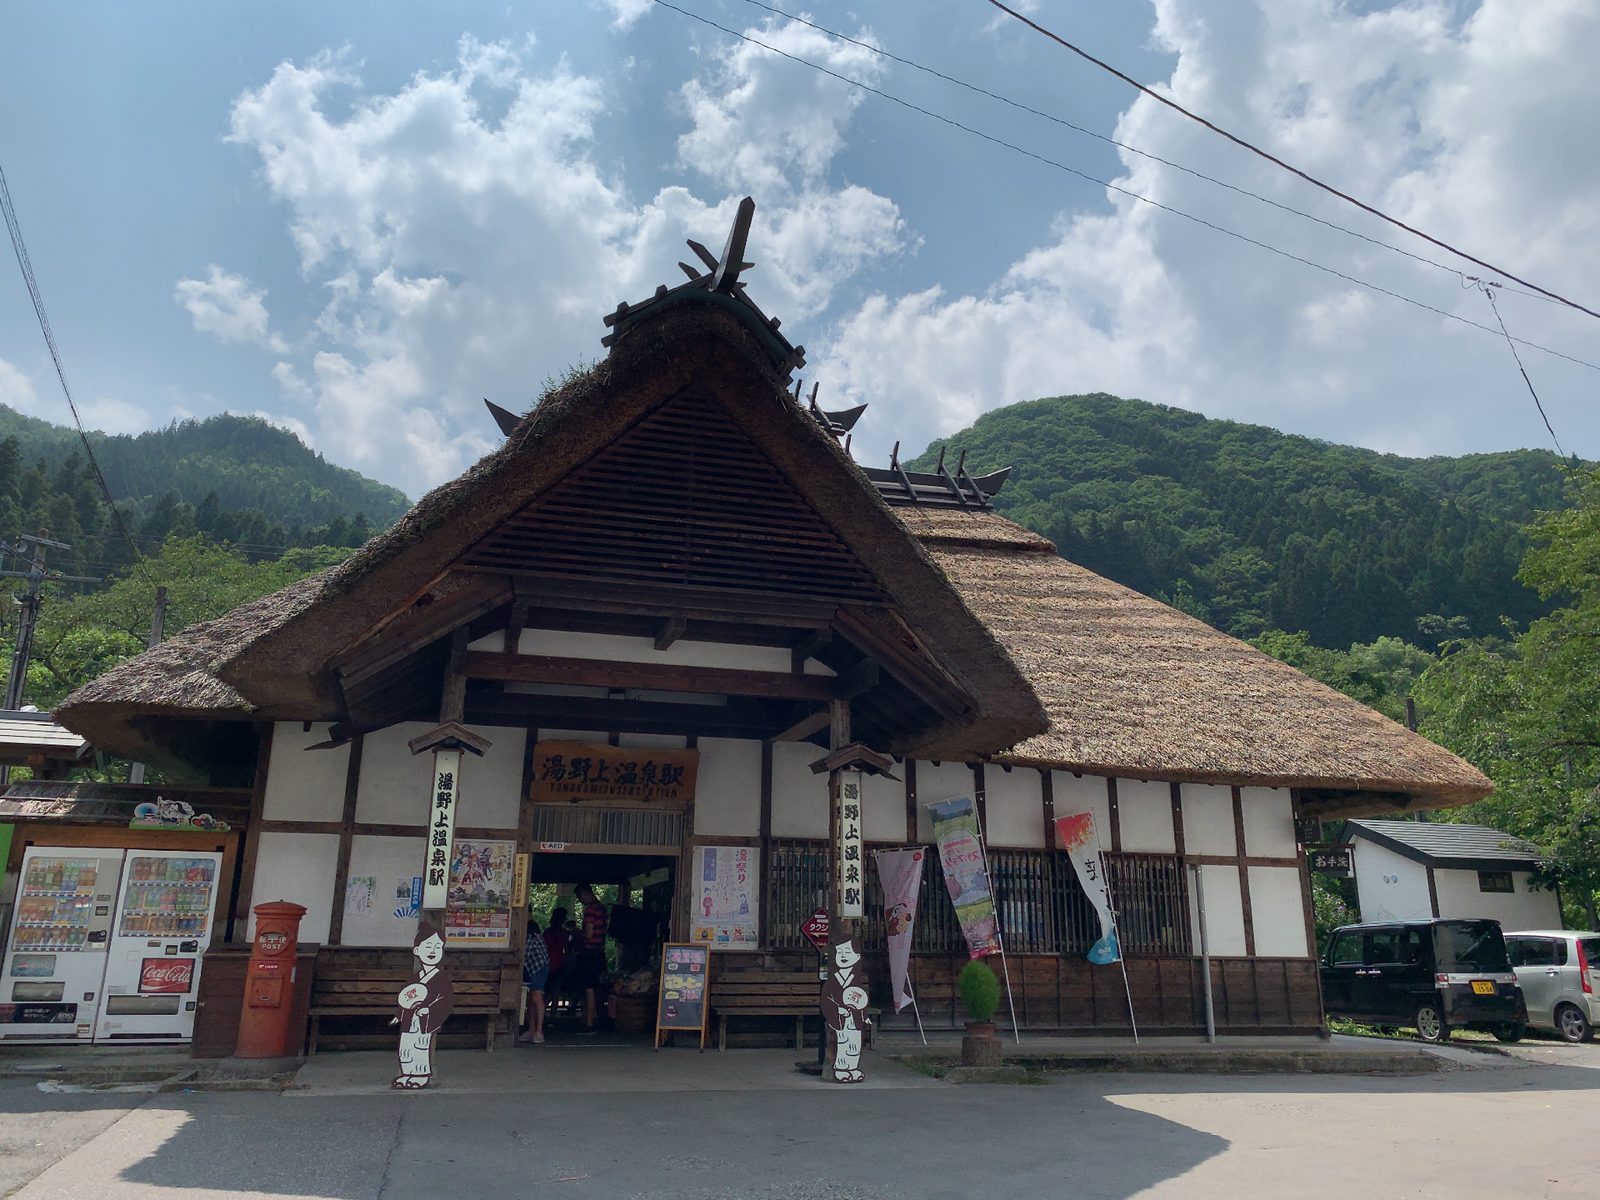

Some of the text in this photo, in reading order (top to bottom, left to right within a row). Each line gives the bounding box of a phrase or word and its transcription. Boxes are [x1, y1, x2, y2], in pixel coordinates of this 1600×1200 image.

[542, 755, 685, 787] 湯野上温泉駅
[429, 773, 453, 886] 湯野上温泉駅
[844, 783, 860, 905] 湯野上温泉駅
[809, 924, 829, 932] タクシ
